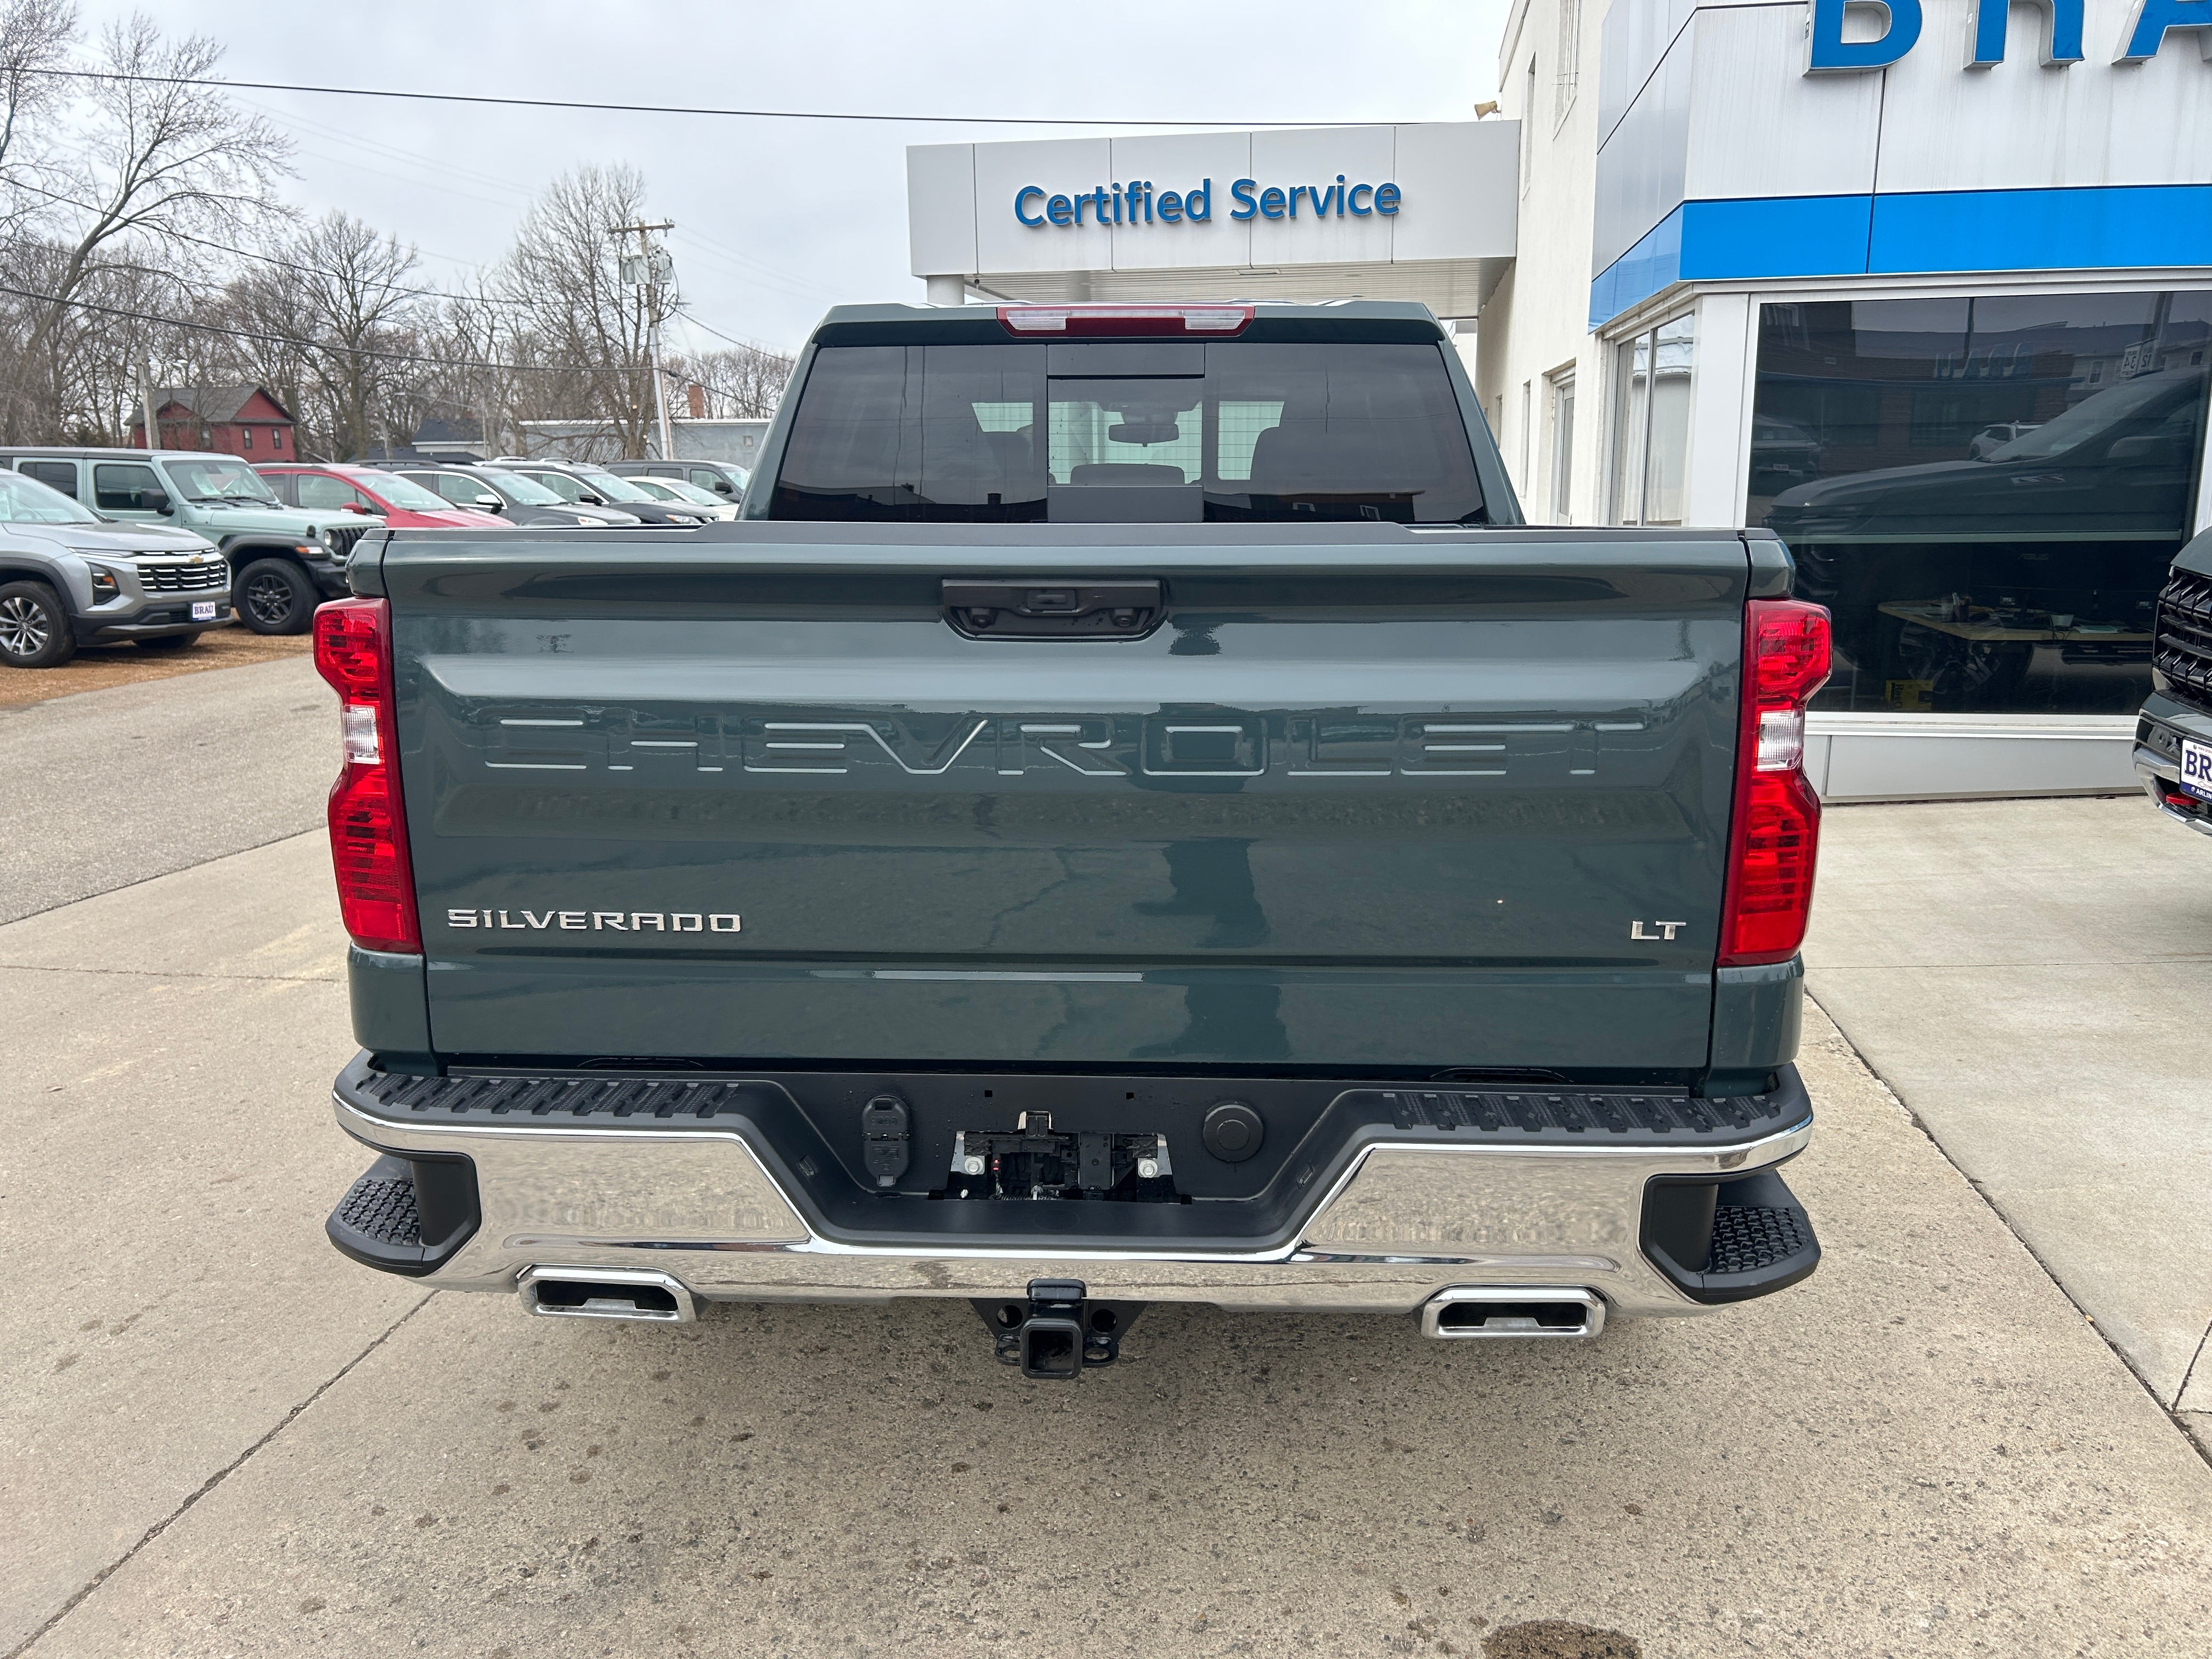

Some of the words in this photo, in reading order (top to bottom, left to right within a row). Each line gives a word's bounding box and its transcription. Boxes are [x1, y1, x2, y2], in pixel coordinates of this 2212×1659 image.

[1014, 178, 1211, 227] Certified
[1230, 174, 1402, 221] Service
[194, 605, 213, 614] BRAU
[479, 708, 1646, 776] CHEVROLET
[447, 909, 742, 933] SILVERADO
[1630, 920, 1687, 940] LT
